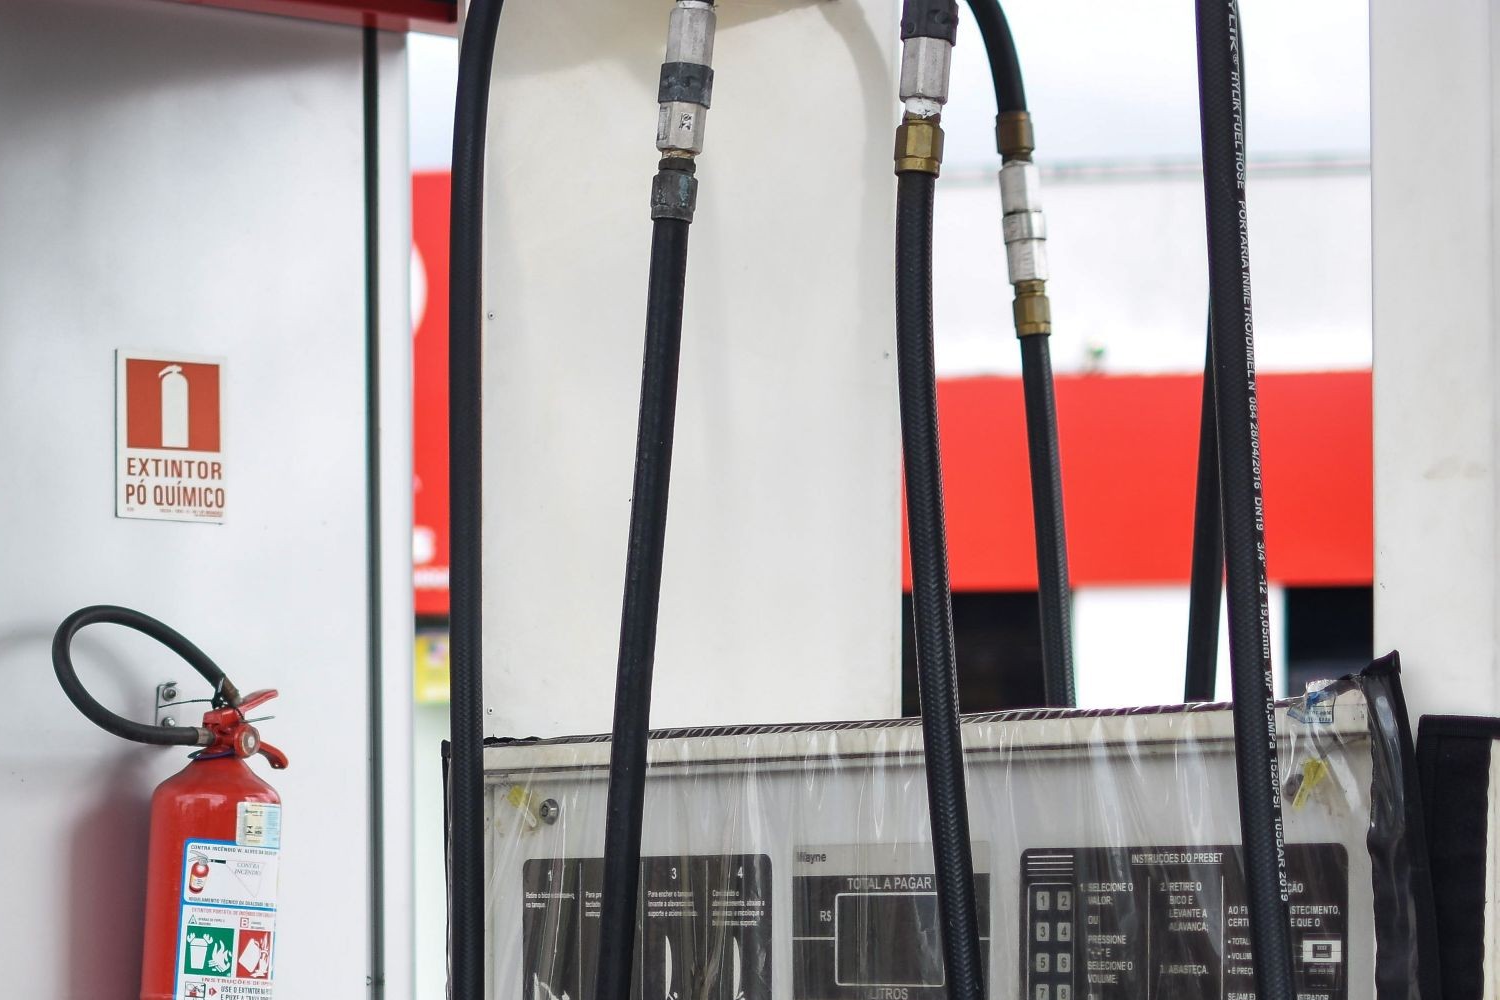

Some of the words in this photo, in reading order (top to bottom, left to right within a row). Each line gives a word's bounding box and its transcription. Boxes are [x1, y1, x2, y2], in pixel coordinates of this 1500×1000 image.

[1231, 71, 1241, 110] HYLIK
[1233, 114, 1243, 149] FUEL
[1236, 151, 1246, 190] HOSE
[1238, 200, 1250, 269] PORTARIA
[1250, 422, 1262, 490] 28/04/2016
[126, 457, 223, 481] EXTINTOR
[125, 478, 147, 505] PÓ
[153, 481, 225, 508] QUÍMICO
[1254, 497, 1265, 531] DN19
[797, 851, 827, 865] Wayne
[1131, 853, 1179, 864] INSTRUÇÕES
[1181, 853, 1192, 863] DO
[1193, 852, 1224, 863] PRESET
[671, 867, 677, 880] 3
[736, 866, 744, 879] 4
[847, 877, 880, 890] TOTAL
[884, 877, 892, 889] A
[893, 876, 932, 890] PAGAR
[1087, 882, 1126, 892] SELECIONE
[1169, 882, 1195, 892] RETIRE
[1278, 871, 1289, 902] 2019
[1169, 895, 1187, 905] BICO
[820, 910, 832, 922] R$
[1169, 908, 1201, 919] LEVANTE
[1228, 905, 1238, 915] AO
[1296, 918, 1313, 927] QUE
[1087, 935, 1127, 945] PRESSIONE
[1232, 937, 1250, 946] TOTAL
[1087, 961, 1126, 971] SELECIONE
[870, 988, 909, 1000] LITROS
